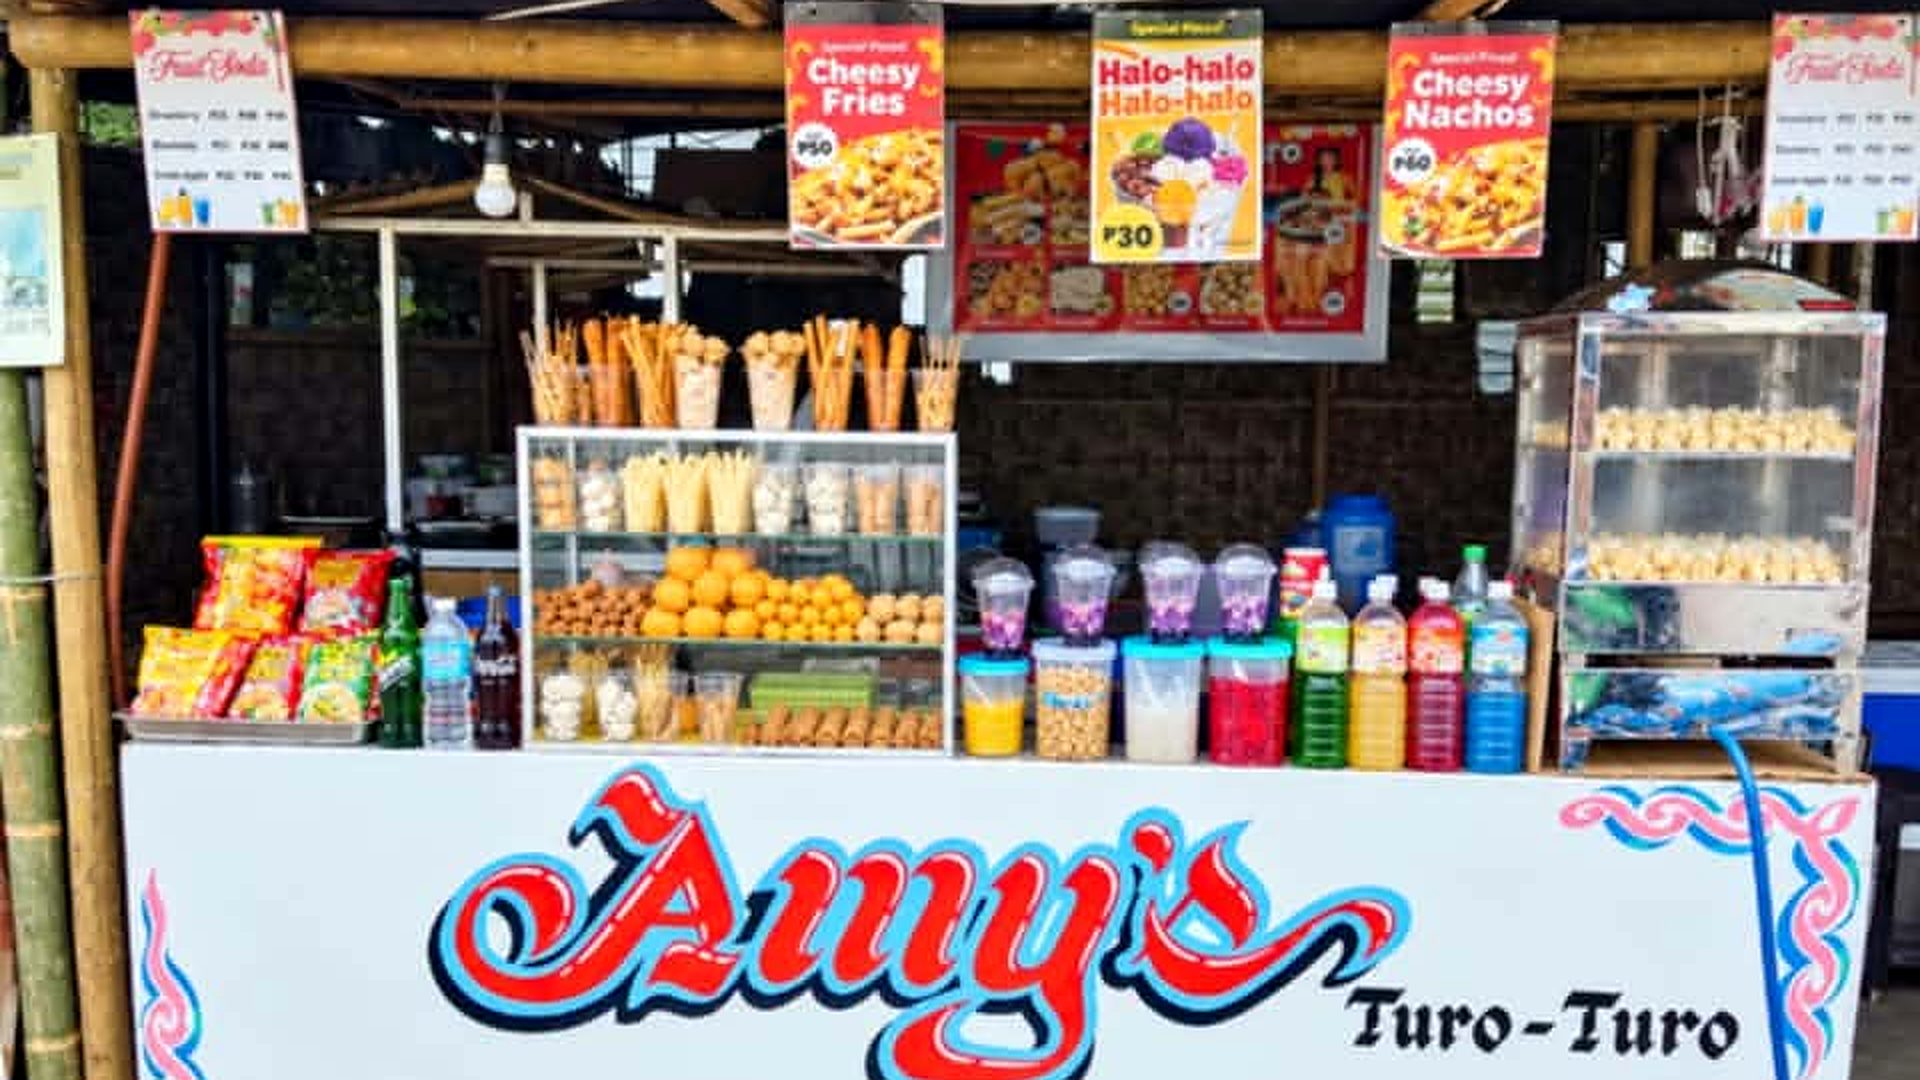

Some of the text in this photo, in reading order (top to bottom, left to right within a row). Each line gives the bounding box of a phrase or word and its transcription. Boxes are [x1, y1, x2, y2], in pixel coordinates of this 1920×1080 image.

[806, 57, 921, 90] Cheesy
[1098, 51, 1255, 85] Halo-halo
[821, 86, 907, 116] Fries
[1099, 84, 1254, 116] Halo-halo
[1413, 69, 1531, 102] Cheesy
[1403, 99, 1535, 129] Nachos
[429, 761, 1412, 1080] Amy's
[1343, 985, 1740, 1061] Turo-Turo
